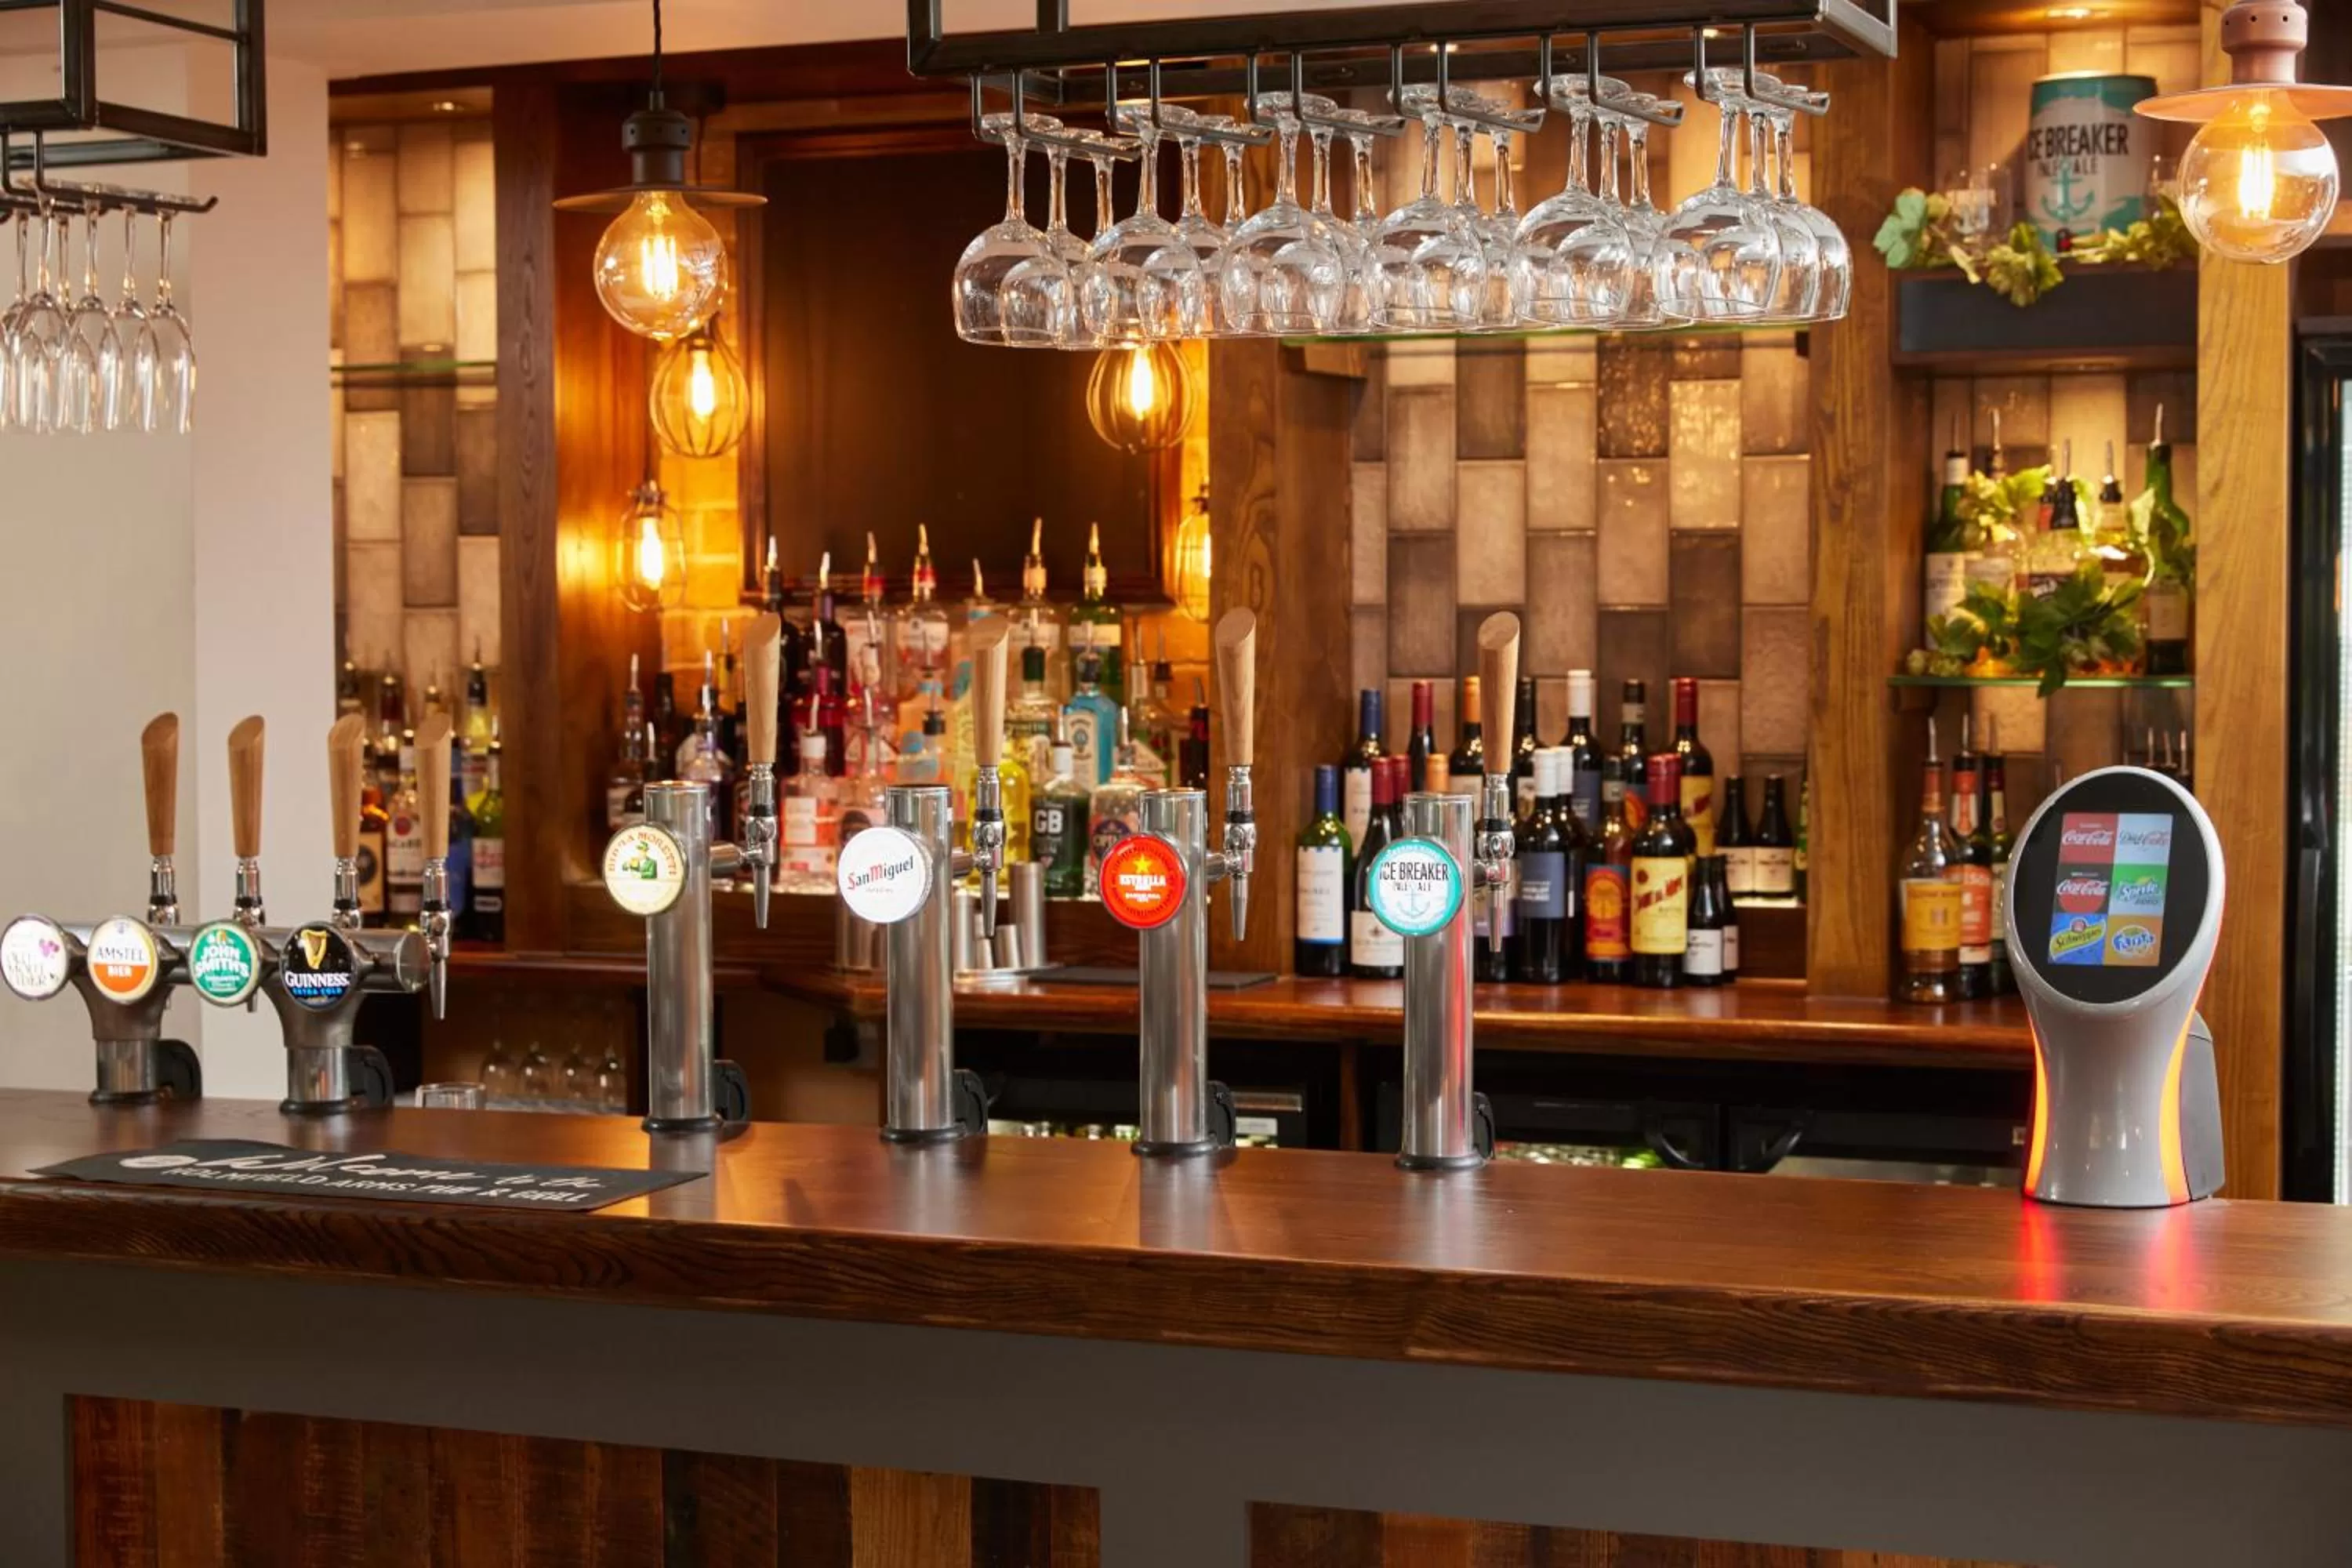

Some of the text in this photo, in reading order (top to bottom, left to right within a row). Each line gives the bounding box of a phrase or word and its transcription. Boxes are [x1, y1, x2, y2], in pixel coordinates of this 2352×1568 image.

[2045, 122, 2130, 157] BREAKER
[2073, 158, 2098, 174] ALE
[1035, 809, 1063, 834] GB
[637, 832, 678, 877] MORETTI
[1380, 862, 1450, 881] ICE BREAKER
[1119, 874, 1167, 887] ESTRELLA
[2114, 932, 2154, 950] Fanta
[96, 946, 145, 962] AMSTEL
[201, 944, 241, 960] JOHN
[107, 965, 132, 978] BIER
[194, 957, 251, 978] SMITH'S
[285, 971, 350, 988] GUINNESS
[324, 1178, 417, 1191] ARMS
